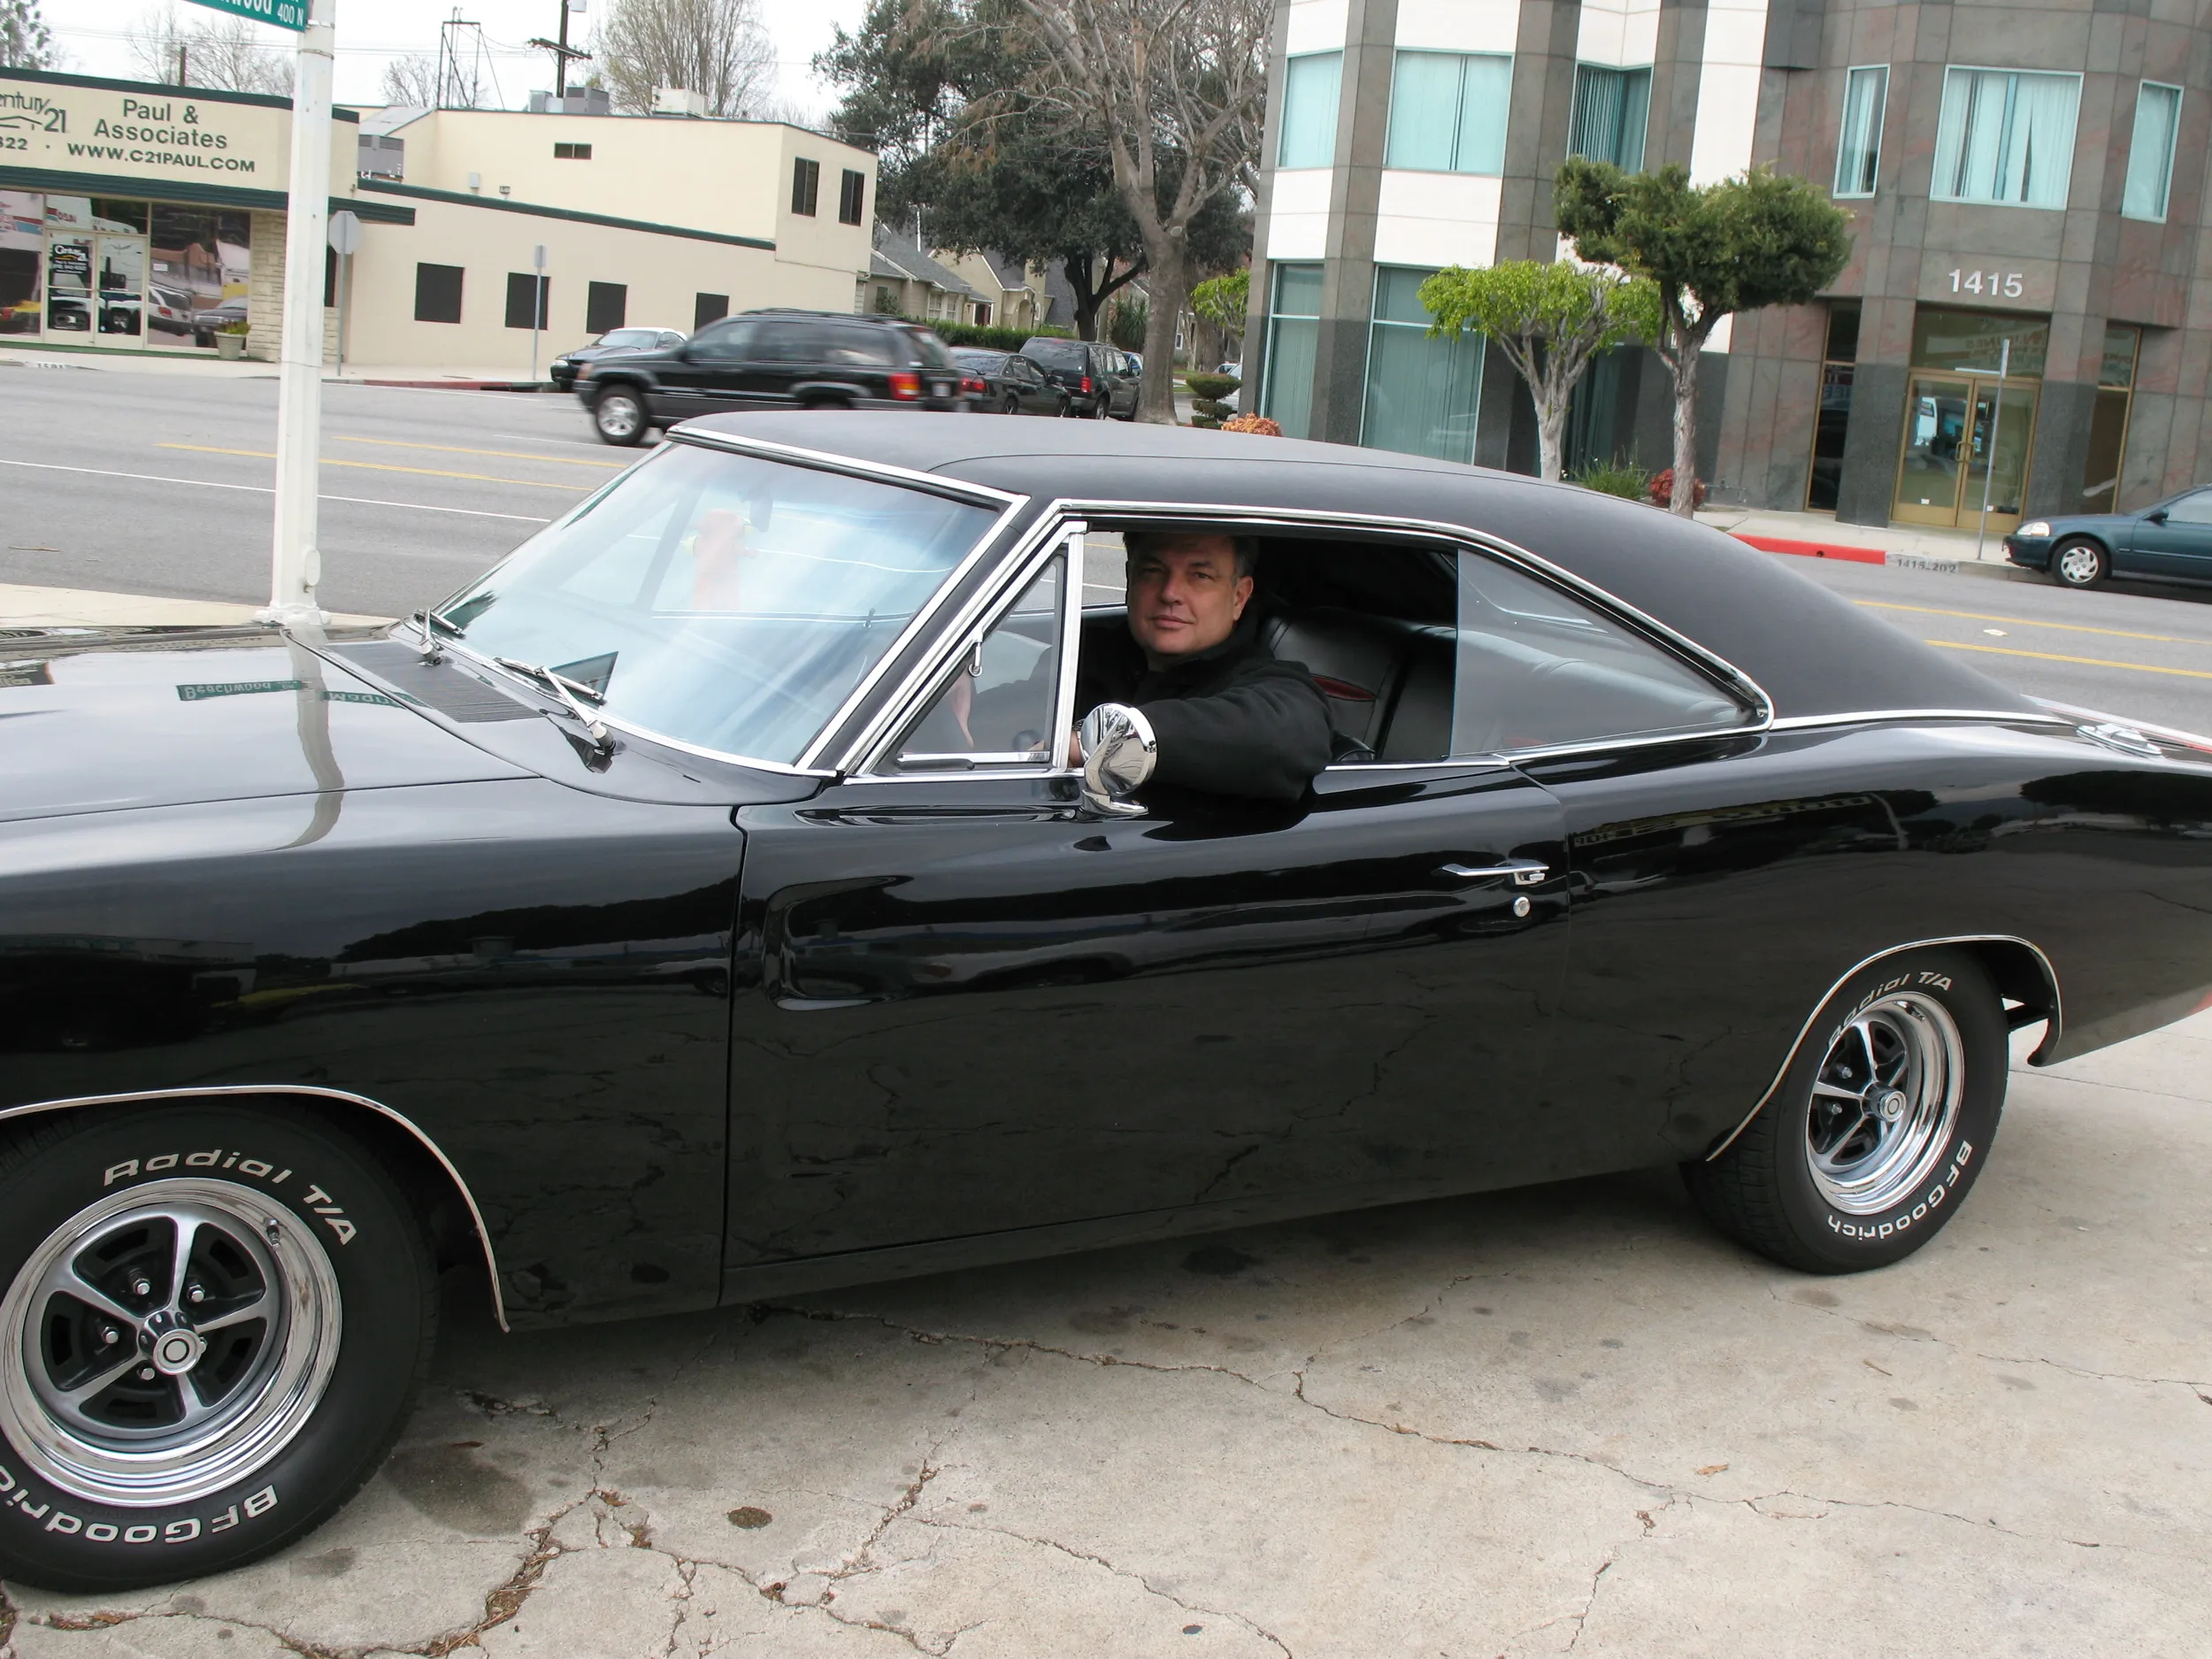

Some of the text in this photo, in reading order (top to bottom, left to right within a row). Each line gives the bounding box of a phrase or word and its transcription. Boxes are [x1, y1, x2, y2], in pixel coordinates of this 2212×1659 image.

[277, 3, 295, 25] 400
[296, 8, 304, 27] N
[43, 107, 66, 134] 21
[123, 98, 199, 125] Paul &
[94, 118, 228, 150] Associates
[67, 142, 256, 173] WWW.C21PAUL.COM
[1948, 268, 2024, 298] 1415
[1918, 972, 1953, 991] T/A
[104, 1148, 357, 1246] Radial T/A
